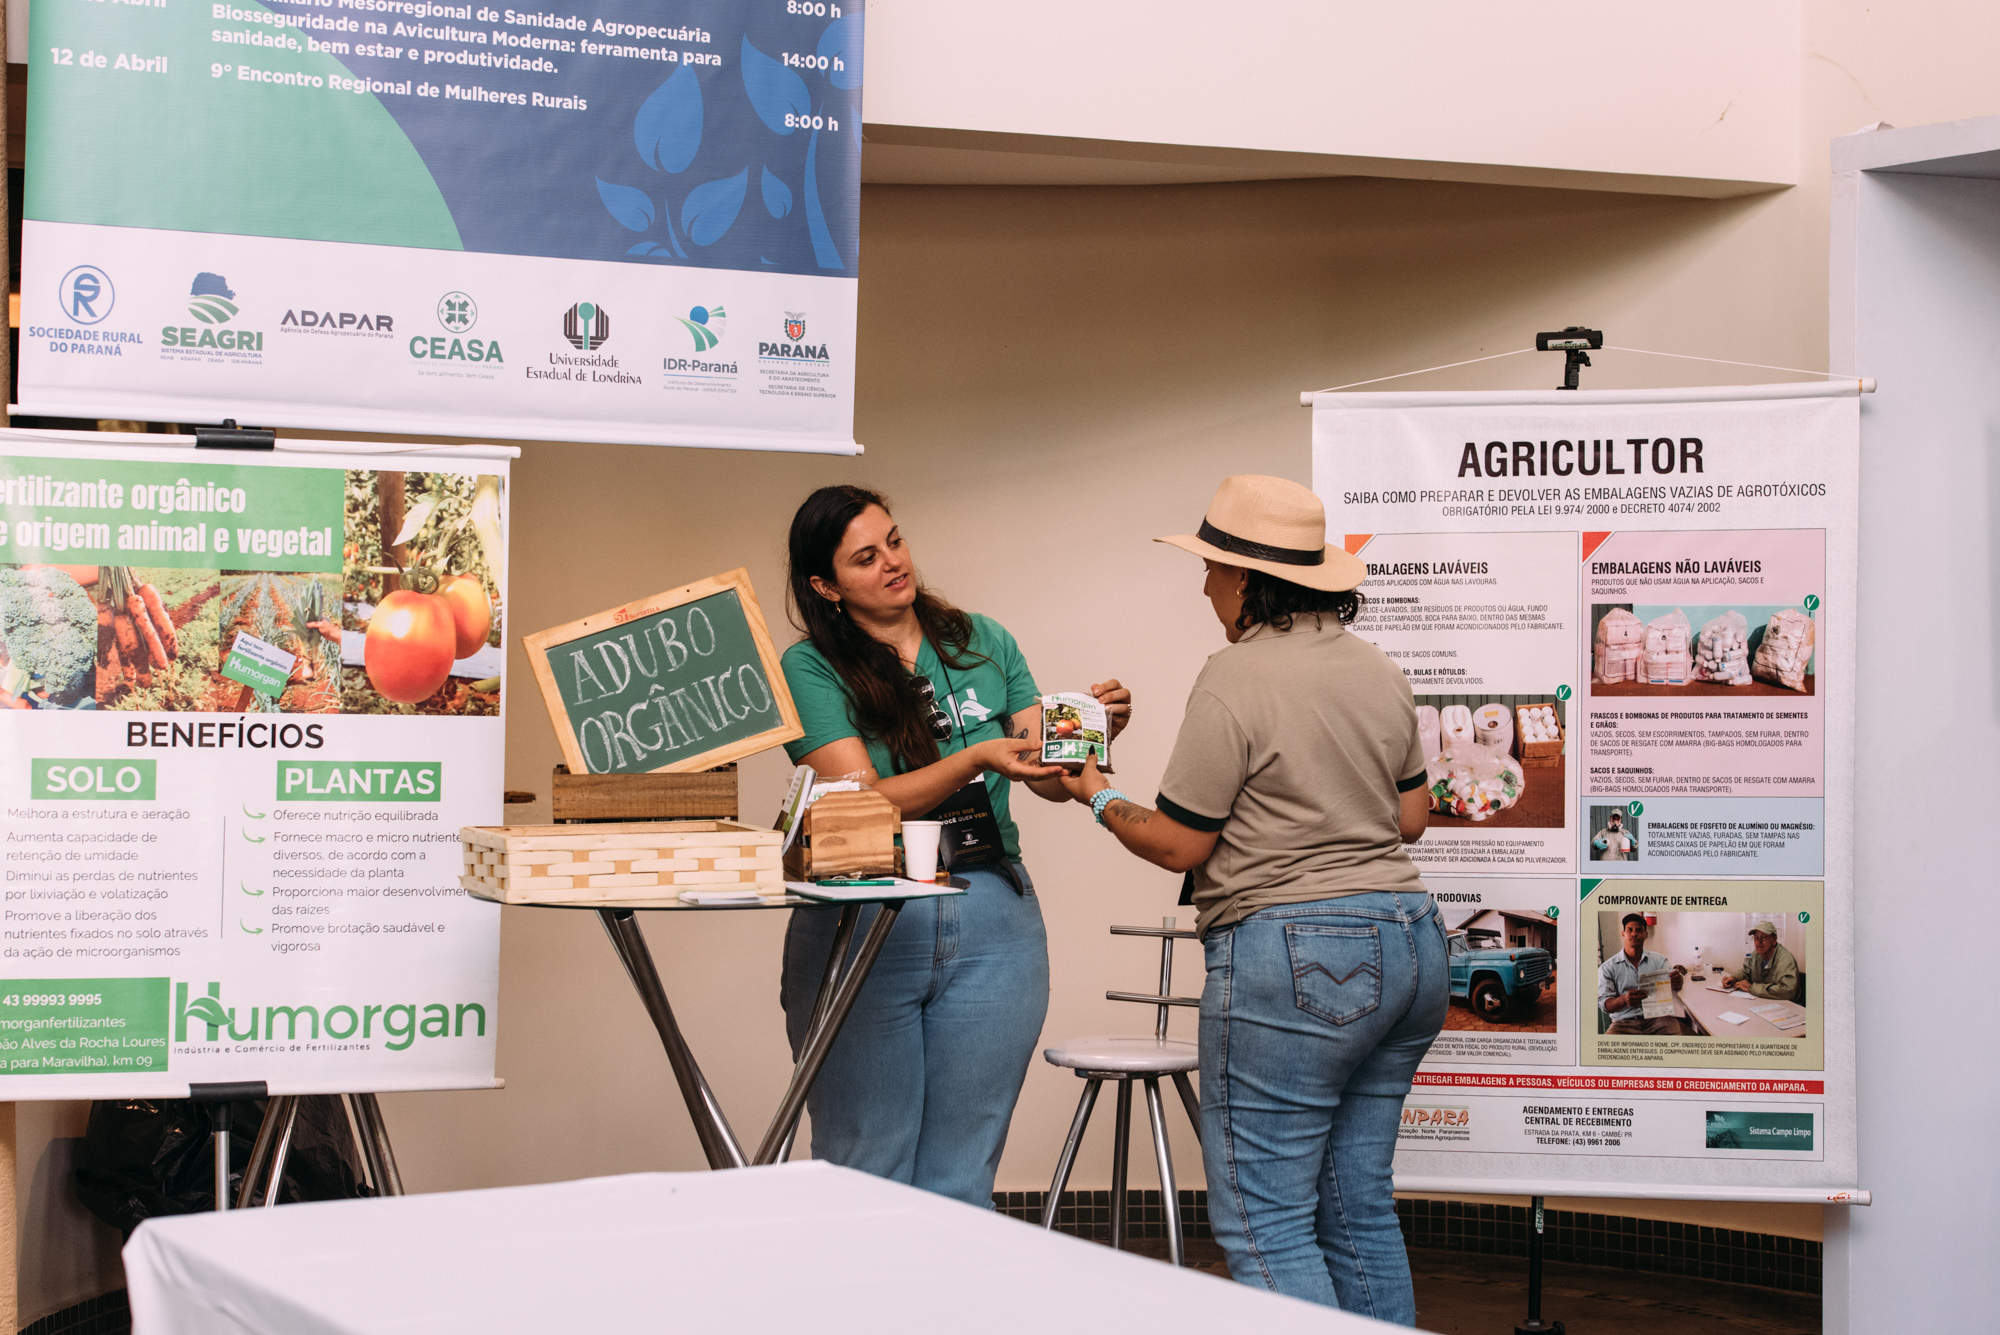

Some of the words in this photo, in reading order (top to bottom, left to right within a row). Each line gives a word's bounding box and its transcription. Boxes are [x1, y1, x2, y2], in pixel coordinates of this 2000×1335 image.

[786, 0, 825, 17] 8:00
[830, 3, 841, 18] h
[476, 6, 499, 22] de
[503, 9, 587, 31] Sanidade
[591, 18, 710, 43] Agropecuária
[213, 4, 359, 32] Biosseguridade
[364, 21, 387, 34] na
[392, 21, 487, 44] Avicultura
[492, 30, 575, 52] Moderna:
[580, 38, 678, 62] ferramenta
[682, 51, 721, 66] para
[50, 47, 73, 65] 12
[79, 49, 107, 68] de
[113, 53, 167, 73] Abril
[212, 30, 301, 52] sanidade,
[308, 36, 349, 54] bem
[354, 42, 403, 58] estar
[407, 48, 419, 60] e
[423, 49, 558, 73] produtividade.
[781, 52, 828, 70] 14:00
[833, 56, 844, 71] h
[238, 65, 322, 87] Encontro
[329, 75, 411, 95] Regional
[416, 81, 439, 98] de
[444, 84, 527, 105] Mulheres
[531, 91, 587, 110] Rurais
[784, 113, 823, 130] 8:00
[828, 116, 838, 131] h
[280, 309, 393, 332] ADAPAR
[28, 326, 99, 341] SOCIEDADE
[102, 331, 143, 344] RURAL
[160, 325, 263, 351] SEAGRI
[49, 341, 68, 353] DO
[70, 342, 122, 356] PARANÁ
[409, 335, 504, 363] CEASA
[758, 341, 829, 360] PARANÁ
[663, 357, 737, 374] IDR-Paraná
[1457, 437, 1703, 477] AGRICULTOR
[0, 474, 123, 509] rtilizante
[130, 478, 246, 514] orgânico
[1343, 491, 1378, 504] SAIBA
[1382, 490, 1416, 503] COMO
[1420, 489, 1483, 502] PREPARAR
[1488, 489, 1494, 501] E
[1498, 488, 1560, 501] DEVOLVER
[1564, 487, 1580, 500] AS
[1584, 486, 1666, 500] EMBALAGENS
[1669, 485, 1713, 498] VAZIAS
[1717, 485, 1733, 497] DE
[1736, 481, 1826, 497] AGROTÓXICOS
[1442, 503, 1508, 516] OBRIGATÓRIO
[1511, 505, 1535, 515] PELA
[1537, 504, 1552, 515] LEI
[1586, 503, 1609, 514] 2000
[1612, 505, 1617, 513] e
[1620, 502, 1665, 513] DECRETO
[1697, 502, 1720, 512] 2002
[16, 521, 109, 551] origem
[117, 519, 206, 552] animal
[213, 527, 229, 553] e
[236, 526, 331, 558] vegetal
[1432, 559, 1488, 574] LAVÁVEIS
[1591, 561, 1671, 574] EMBALAGENS
[1675, 559, 1700, 573] NÃO
[1704, 558, 1761, 573] LAVÁVEIS
[569, 607, 716, 705] ADUBO
[229, 656, 281, 688] Humorgan
[1051, 695, 1096, 710] Humorgan
[580, 664, 772, 775] ORGÂNICO
[126, 715, 323, 749] BENEFÍCIOS
[46, 765, 141, 792] SOLO
[285, 767, 435, 794] PLANTAS
[7, 807, 58, 819] Melhora
[60, 810, 68, 819] a
[71, 808, 127, 819] estrutura
[130, 810, 138, 819] e
[140, 808, 190, 821] aeração
[272, 809, 320, 820] Oferece
[323, 810, 371, 822] nutrição
[374, 810, 438, 823] equilibrada
[1737, 821, 1768, 830] ALUMÍNIO
[1780, 821, 1814, 830] MAGNÉSIO:
[1436, 892, 1481, 903] RODOVIAS
[1598, 895, 1667, 905] COMPROVANTE
[1670, 895, 1682, 905] DE
[1685, 895, 1727, 905] ENTREGA
[2, 994, 19, 1006] 43
[22, 993, 65, 1006] 99993
[68, 993, 102, 1005] 9995
[174, 981, 486, 1054] Humorgan
[20, 1037, 56, 1049] Alves
[59, 1037, 76, 1048] da
[79, 1036, 119, 1048] Rocha
[122, 1035, 165, 1048] Loures
[174, 1046, 220, 1054] Indústria
[234, 1044, 285, 1053] Comércio
[289, 1044, 301, 1052] de
[306, 1043, 370, 1051] Fertilizantes
[1412, 1074, 1452, 1084] ENTREGAR
[1454, 1075, 1506, 1085] EMBALAGENS
[1508, 1077, 1514, 1085] A
[1516, 1077, 1554, 1087] PESSOAS,
[1556, 1076, 1595, 1087] VEÍCULOS
[1597, 1078, 1609, 1087] OU
[1611, 1079, 1654, 1088] EMPRESAS
[1656, 1079, 1673, 1089] SEM
[1675, 1080, 1681, 1089] O
[1683, 1080, 1757, 1091] CREDENCIAMENTO
[1759, 1081, 1770, 1091] DA
[1772, 1082, 1808, 1091] ANPARA.
[1401, 1108, 1469, 1127] NPARA
[1522, 1105, 1582, 1115] AGENDAMENTO
[1584, 1106, 1589, 1115] E
[1592, 1107, 1633, 1116] ENTREGAS
[1524, 1116, 1560, 1125] CENTRAL
[1562, 1117, 1573, 1125] DE
[1575, 1117, 1631, 1127] RECEBIMENTO
[1536, 1136, 1570, 1145] TELEFONE:
[1572, 1137, 1585, 1146] (43)
[1604, 1138, 1620, 1146] 2006
[1749, 1126, 1771, 1135] Sistema
[1771, 1126, 1792, 1137] Campo
[1793, 1127, 1812, 1138] Limpo
